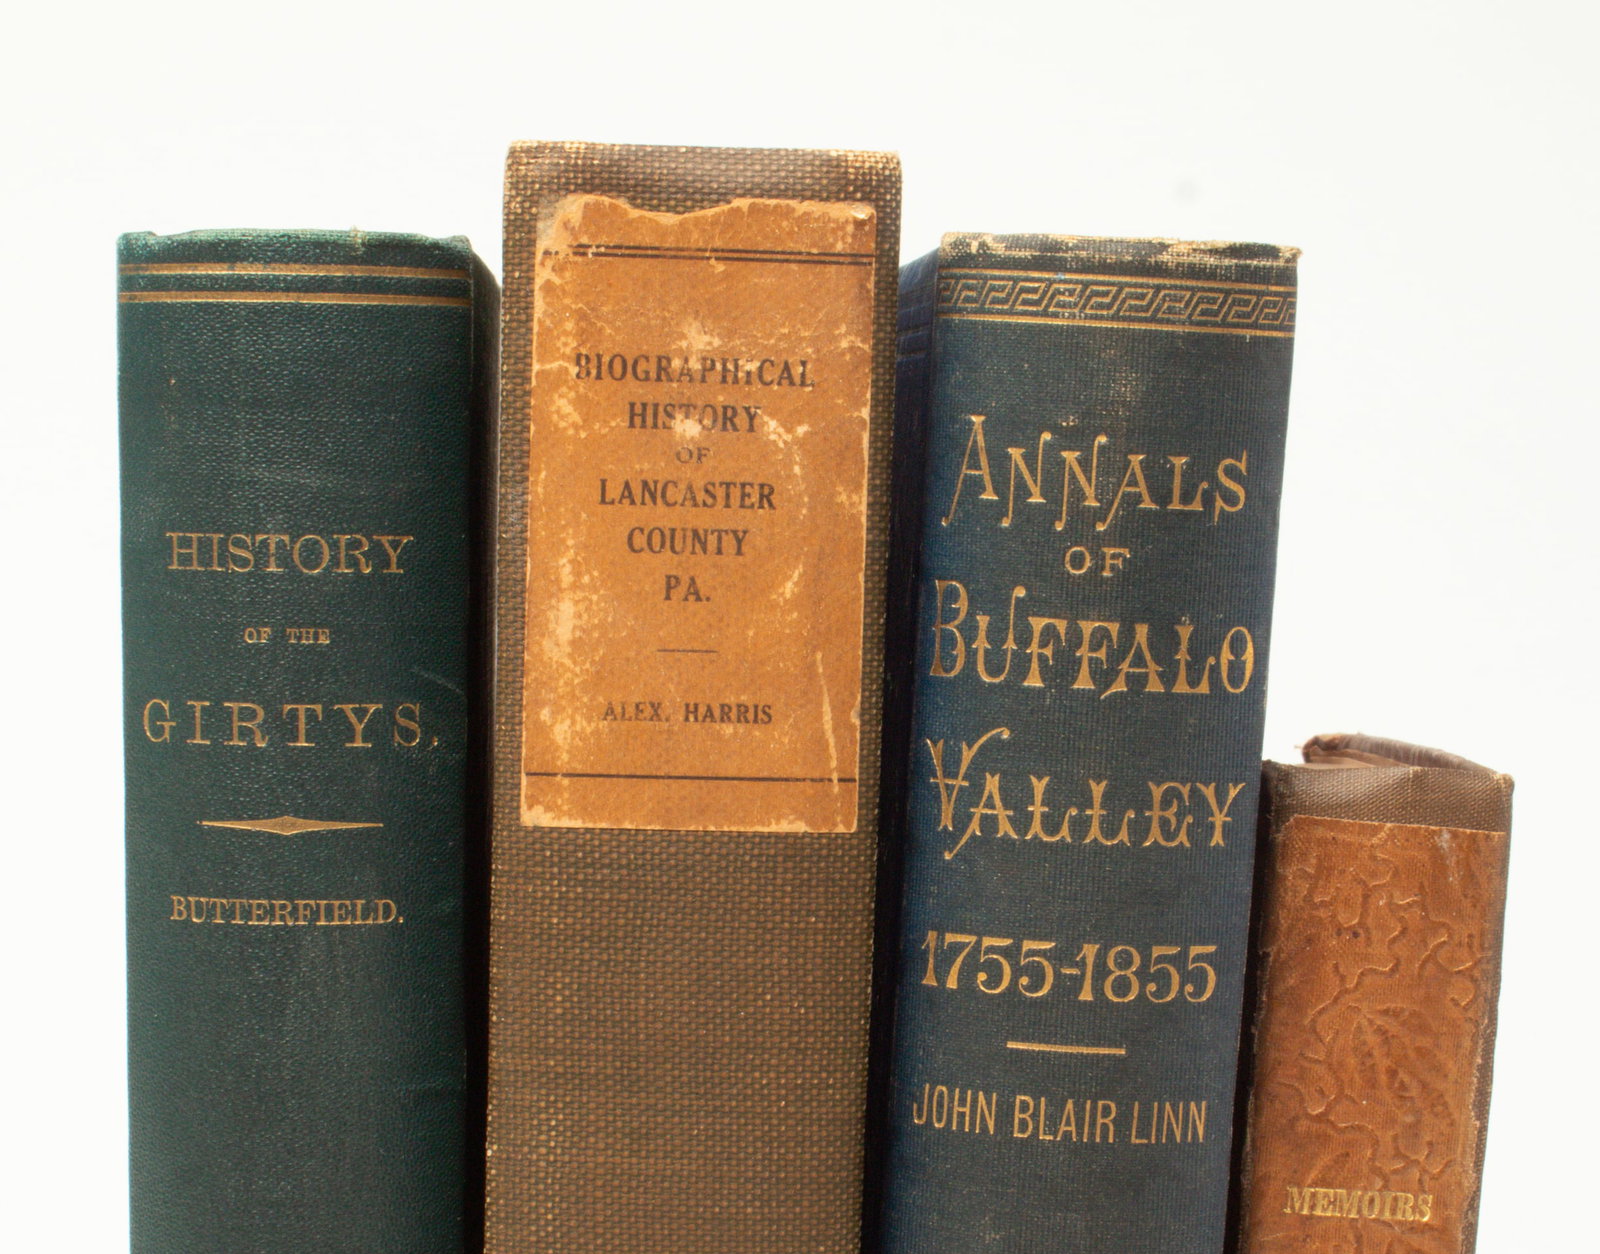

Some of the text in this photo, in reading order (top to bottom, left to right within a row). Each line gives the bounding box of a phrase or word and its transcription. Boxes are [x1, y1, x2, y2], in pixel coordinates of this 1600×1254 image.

[575, 353, 816, 388] BIOGRAPHICAL
[628, 402, 761, 433] HISTORY
[675, 446, 711, 464] OF
[941, 414, 1248, 531] ANNALS
[599, 479, 777, 511] LANCASTER
[166, 532, 414, 574] HISTORY
[627, 527, 750, 557] COUNTY
[1065, 546, 1131, 576] OF
[663, 575, 712, 603] PA.
[243, 628, 331, 645] OF THE
[930, 579, 1255, 700] BUFFALO
[602, 702, 773, 725] ALEX. HARRIS
[926, 727, 1247, 860] VALLEY
[170, 895, 404, 926] BUTTERFIELD.
[921, 930, 1219, 1003] 1755-1855
[912, 1083, 1207, 1145] JOHN BLAIR LINN
[1283, 1186, 1434, 1222] MEMOIRS
